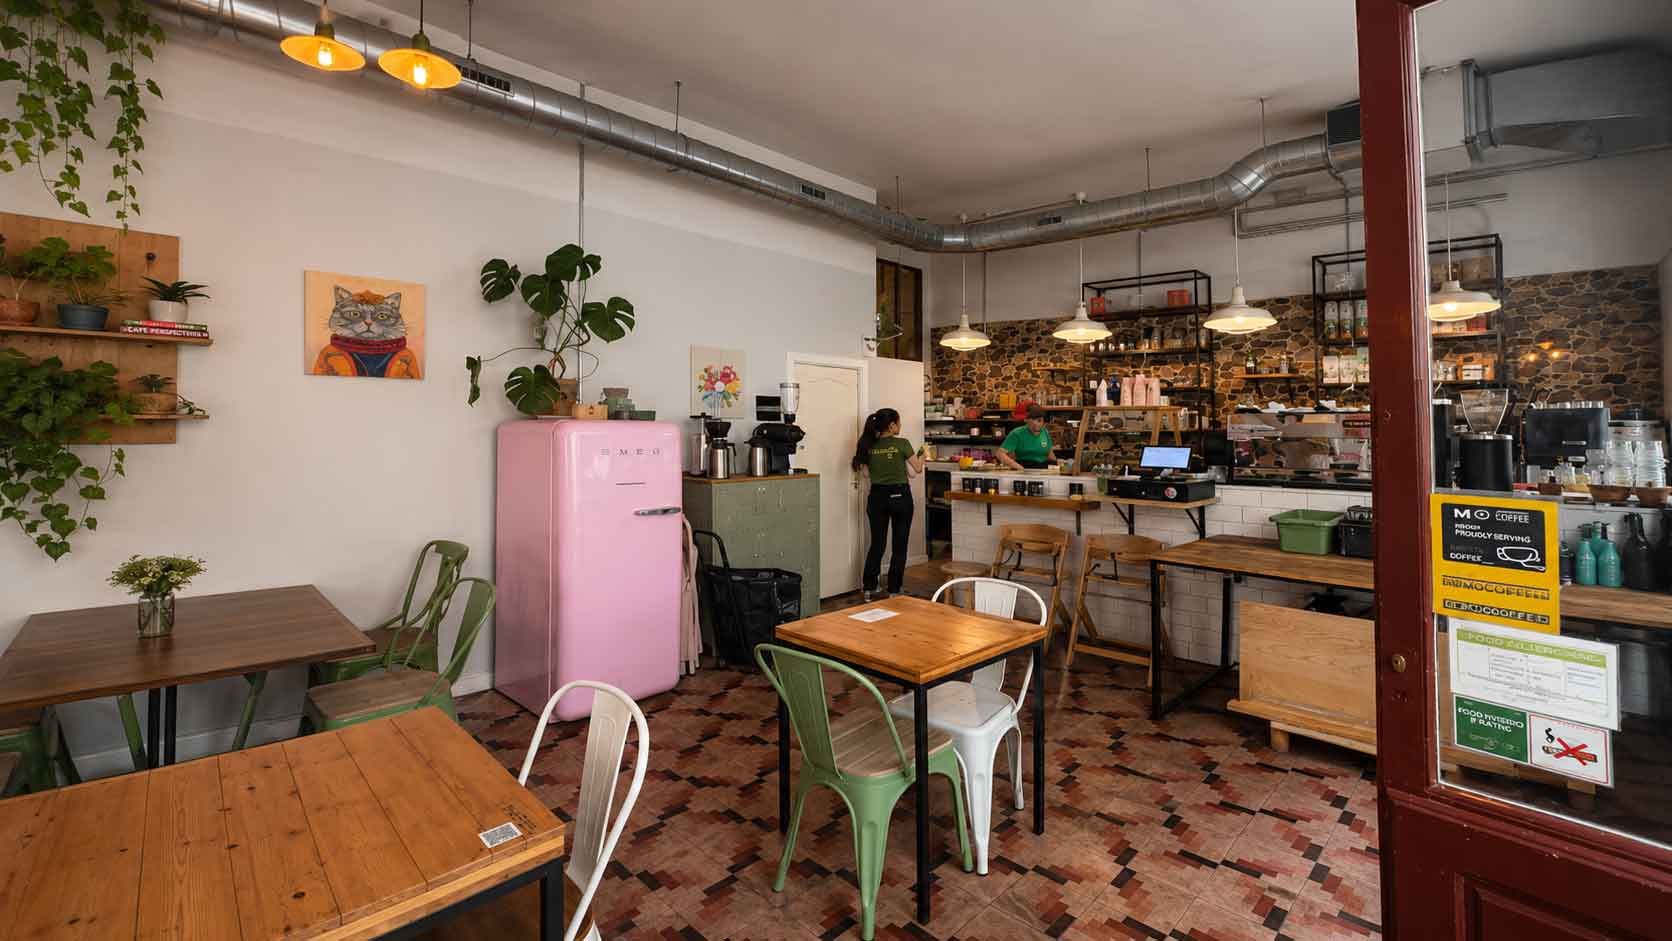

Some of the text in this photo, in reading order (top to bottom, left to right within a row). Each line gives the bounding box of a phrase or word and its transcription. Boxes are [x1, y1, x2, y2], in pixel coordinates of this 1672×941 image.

[1495, 511, 1529, 524] COFFEE
[1455, 529, 1531, 543] PROUDLY SERVING
